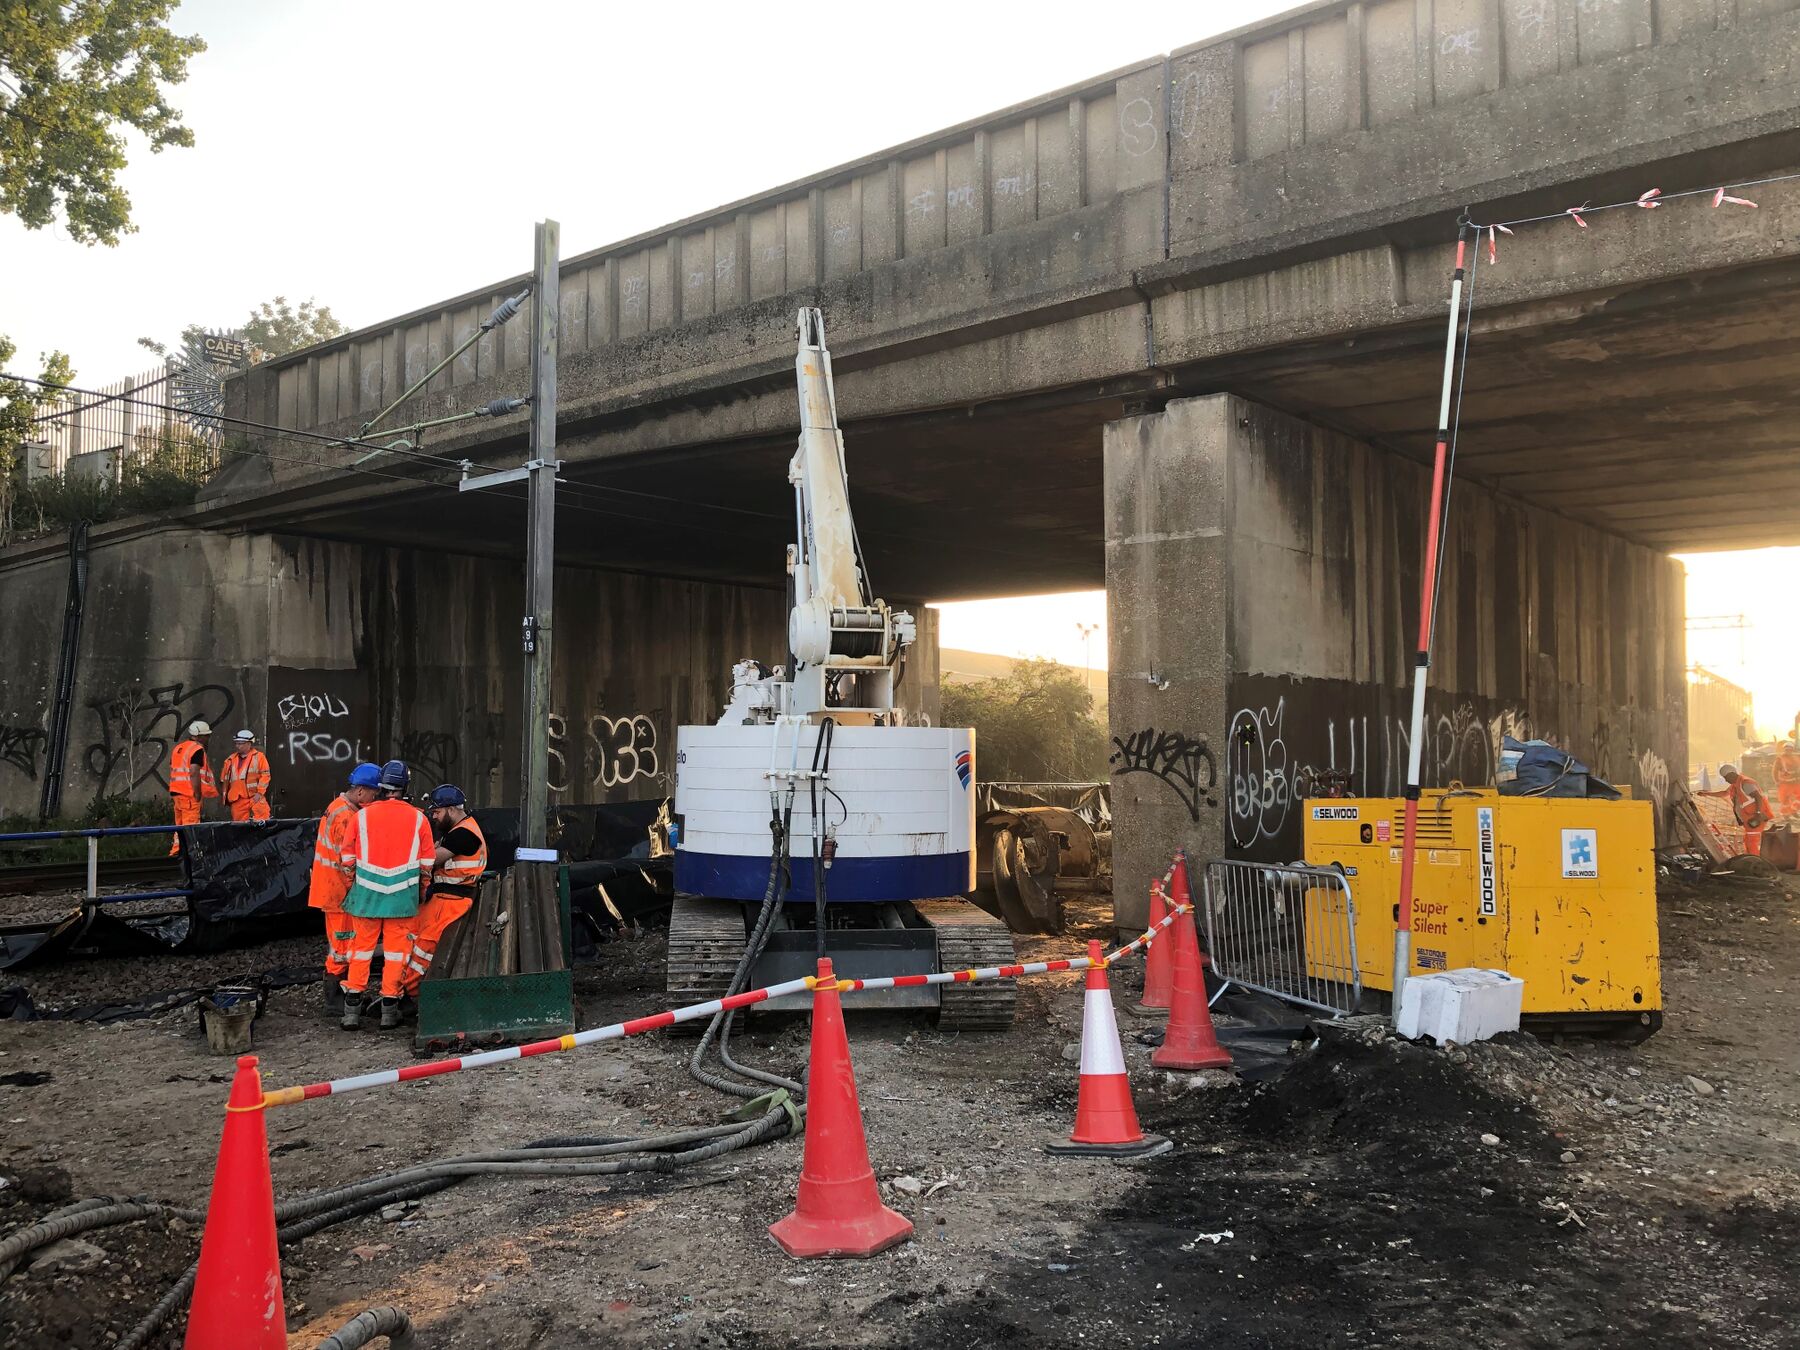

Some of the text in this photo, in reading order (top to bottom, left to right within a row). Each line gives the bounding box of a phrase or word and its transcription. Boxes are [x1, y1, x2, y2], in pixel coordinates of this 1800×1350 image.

[522, 616, 534, 627] AT
[525, 630, 531, 640] 9
[523, 641, 534, 652] 19
[1319, 808, 1358, 819] SELWOOD
[1481, 829, 1494, 914] SELWOOD
[1413, 897, 1448, 918] Super
[1413, 918, 1448, 935] Silent
